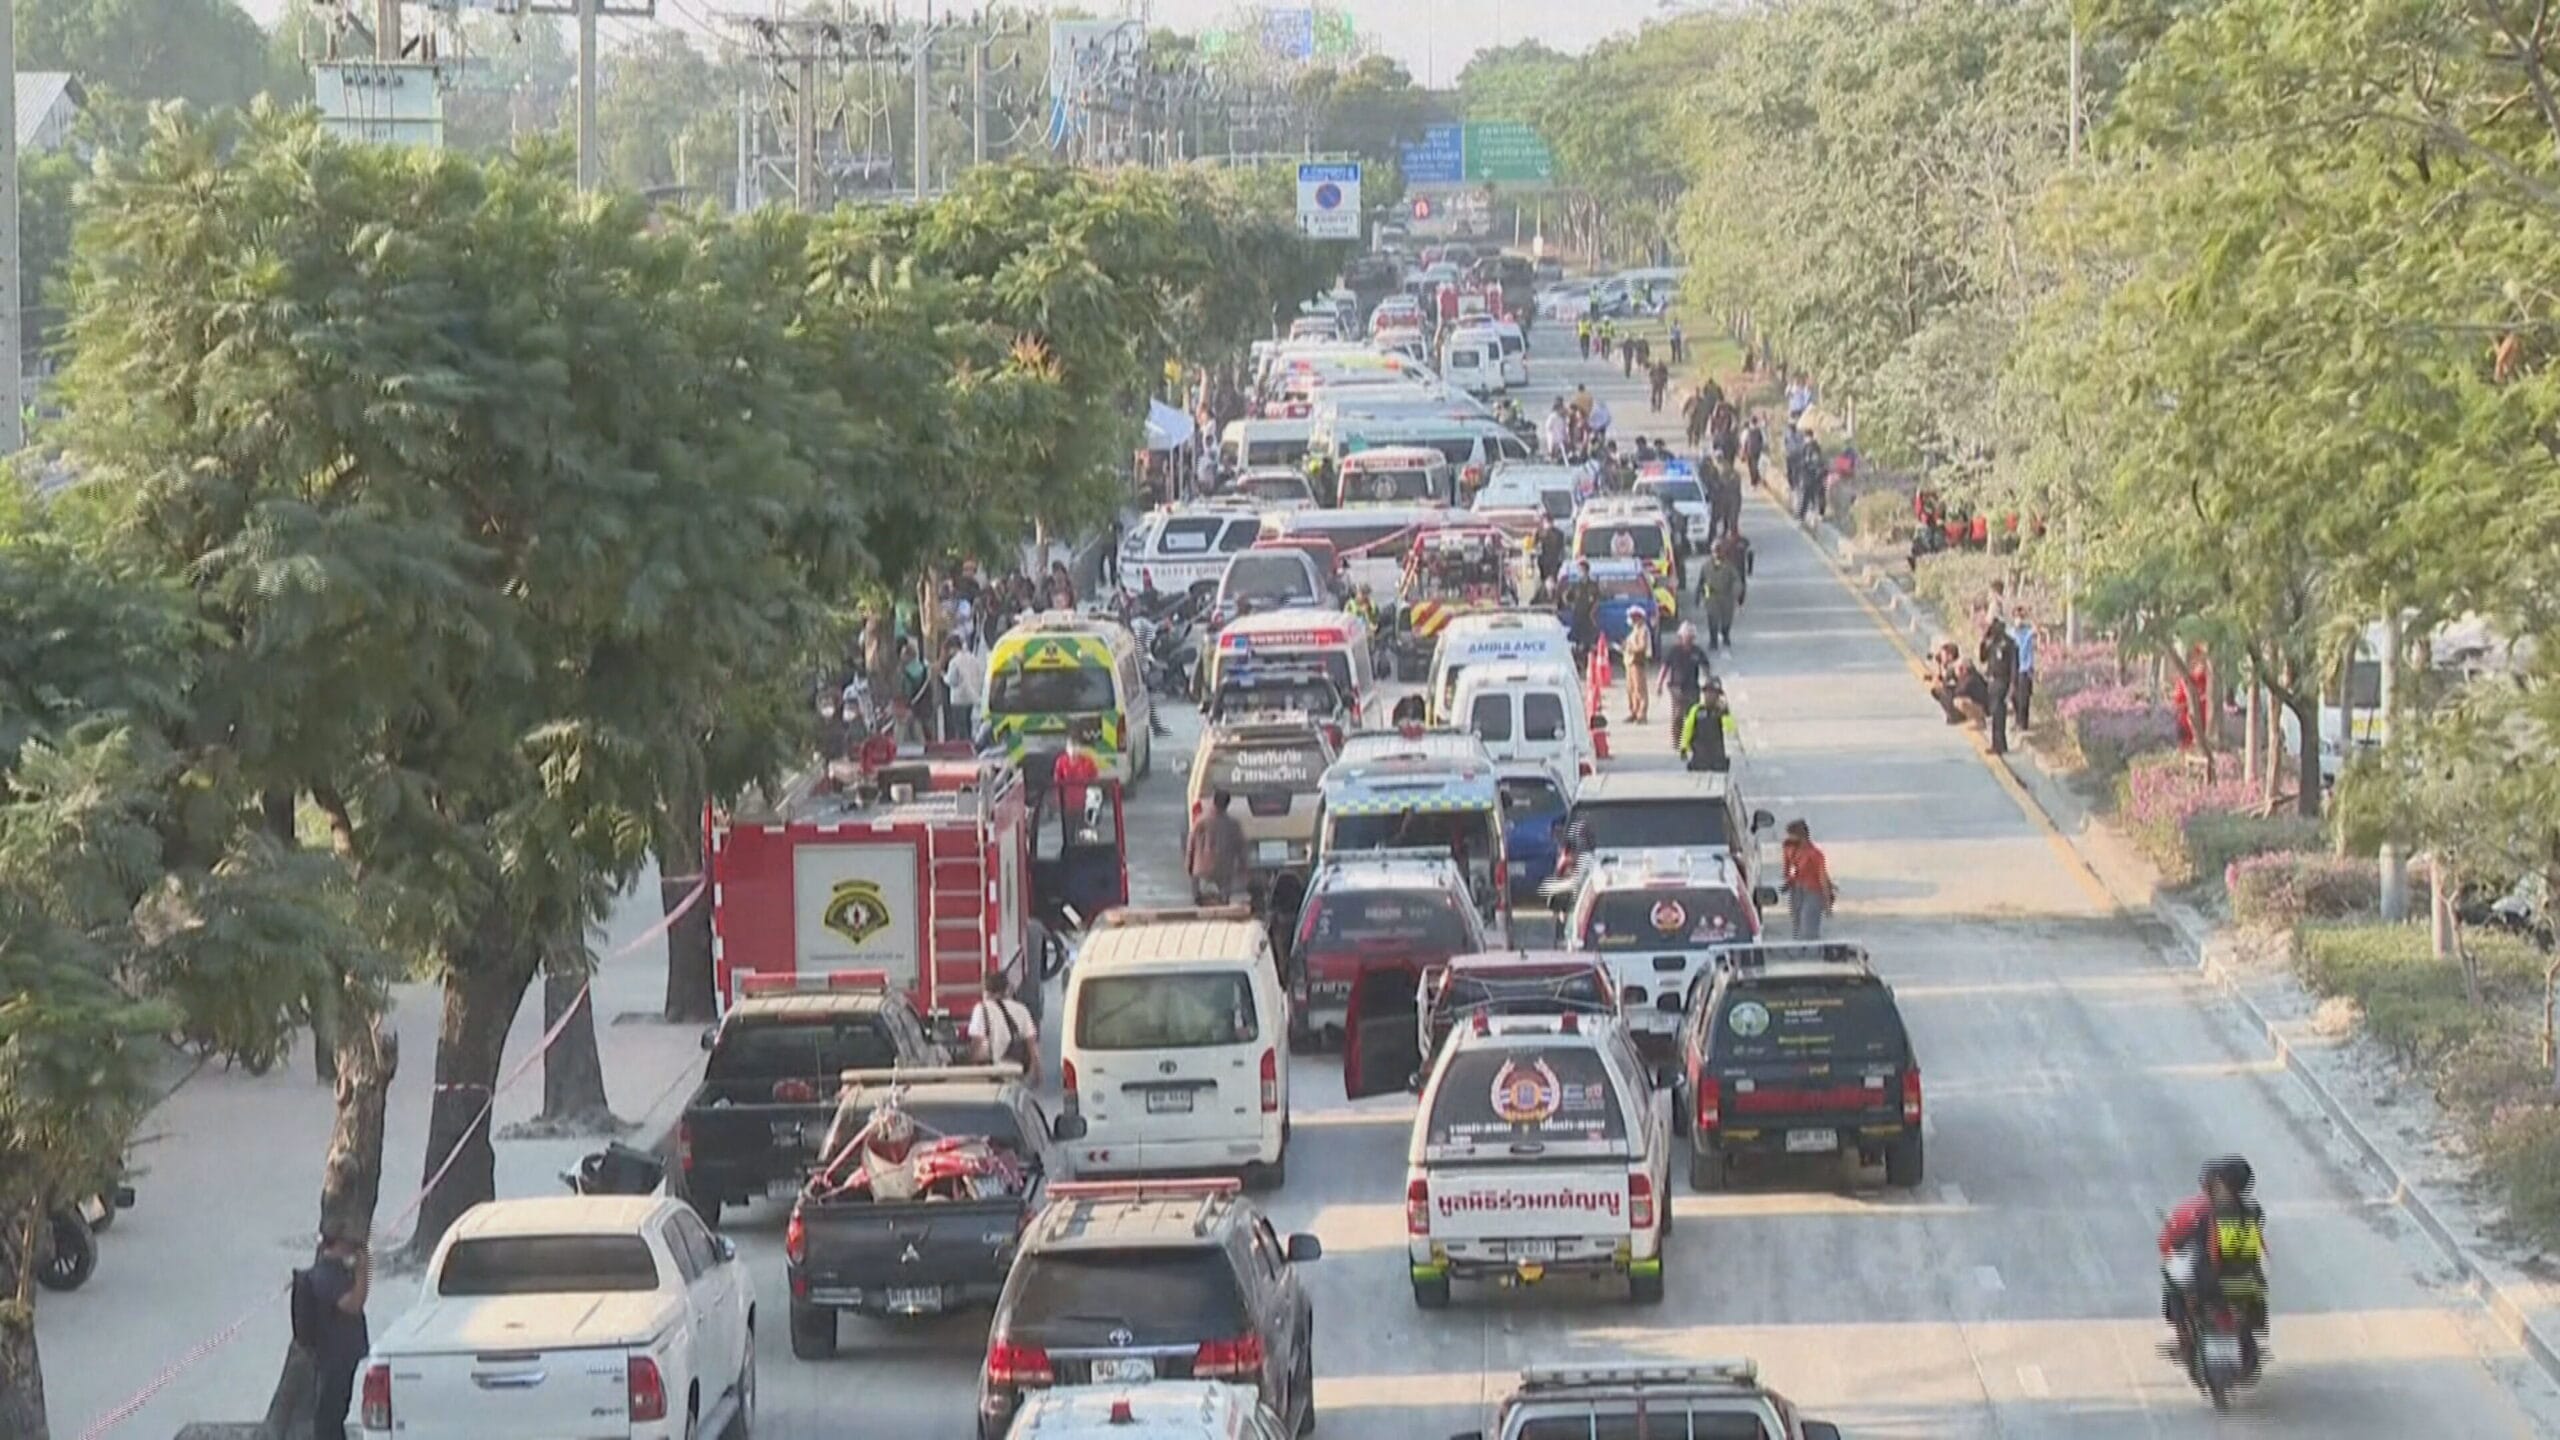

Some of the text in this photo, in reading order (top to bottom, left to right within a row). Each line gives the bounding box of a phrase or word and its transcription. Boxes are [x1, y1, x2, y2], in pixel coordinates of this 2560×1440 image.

[1468, 641, 1547, 654] AMBULANCE
[1438, 1188, 1621, 1217] มูลนิธิร่วมกตัญญู
